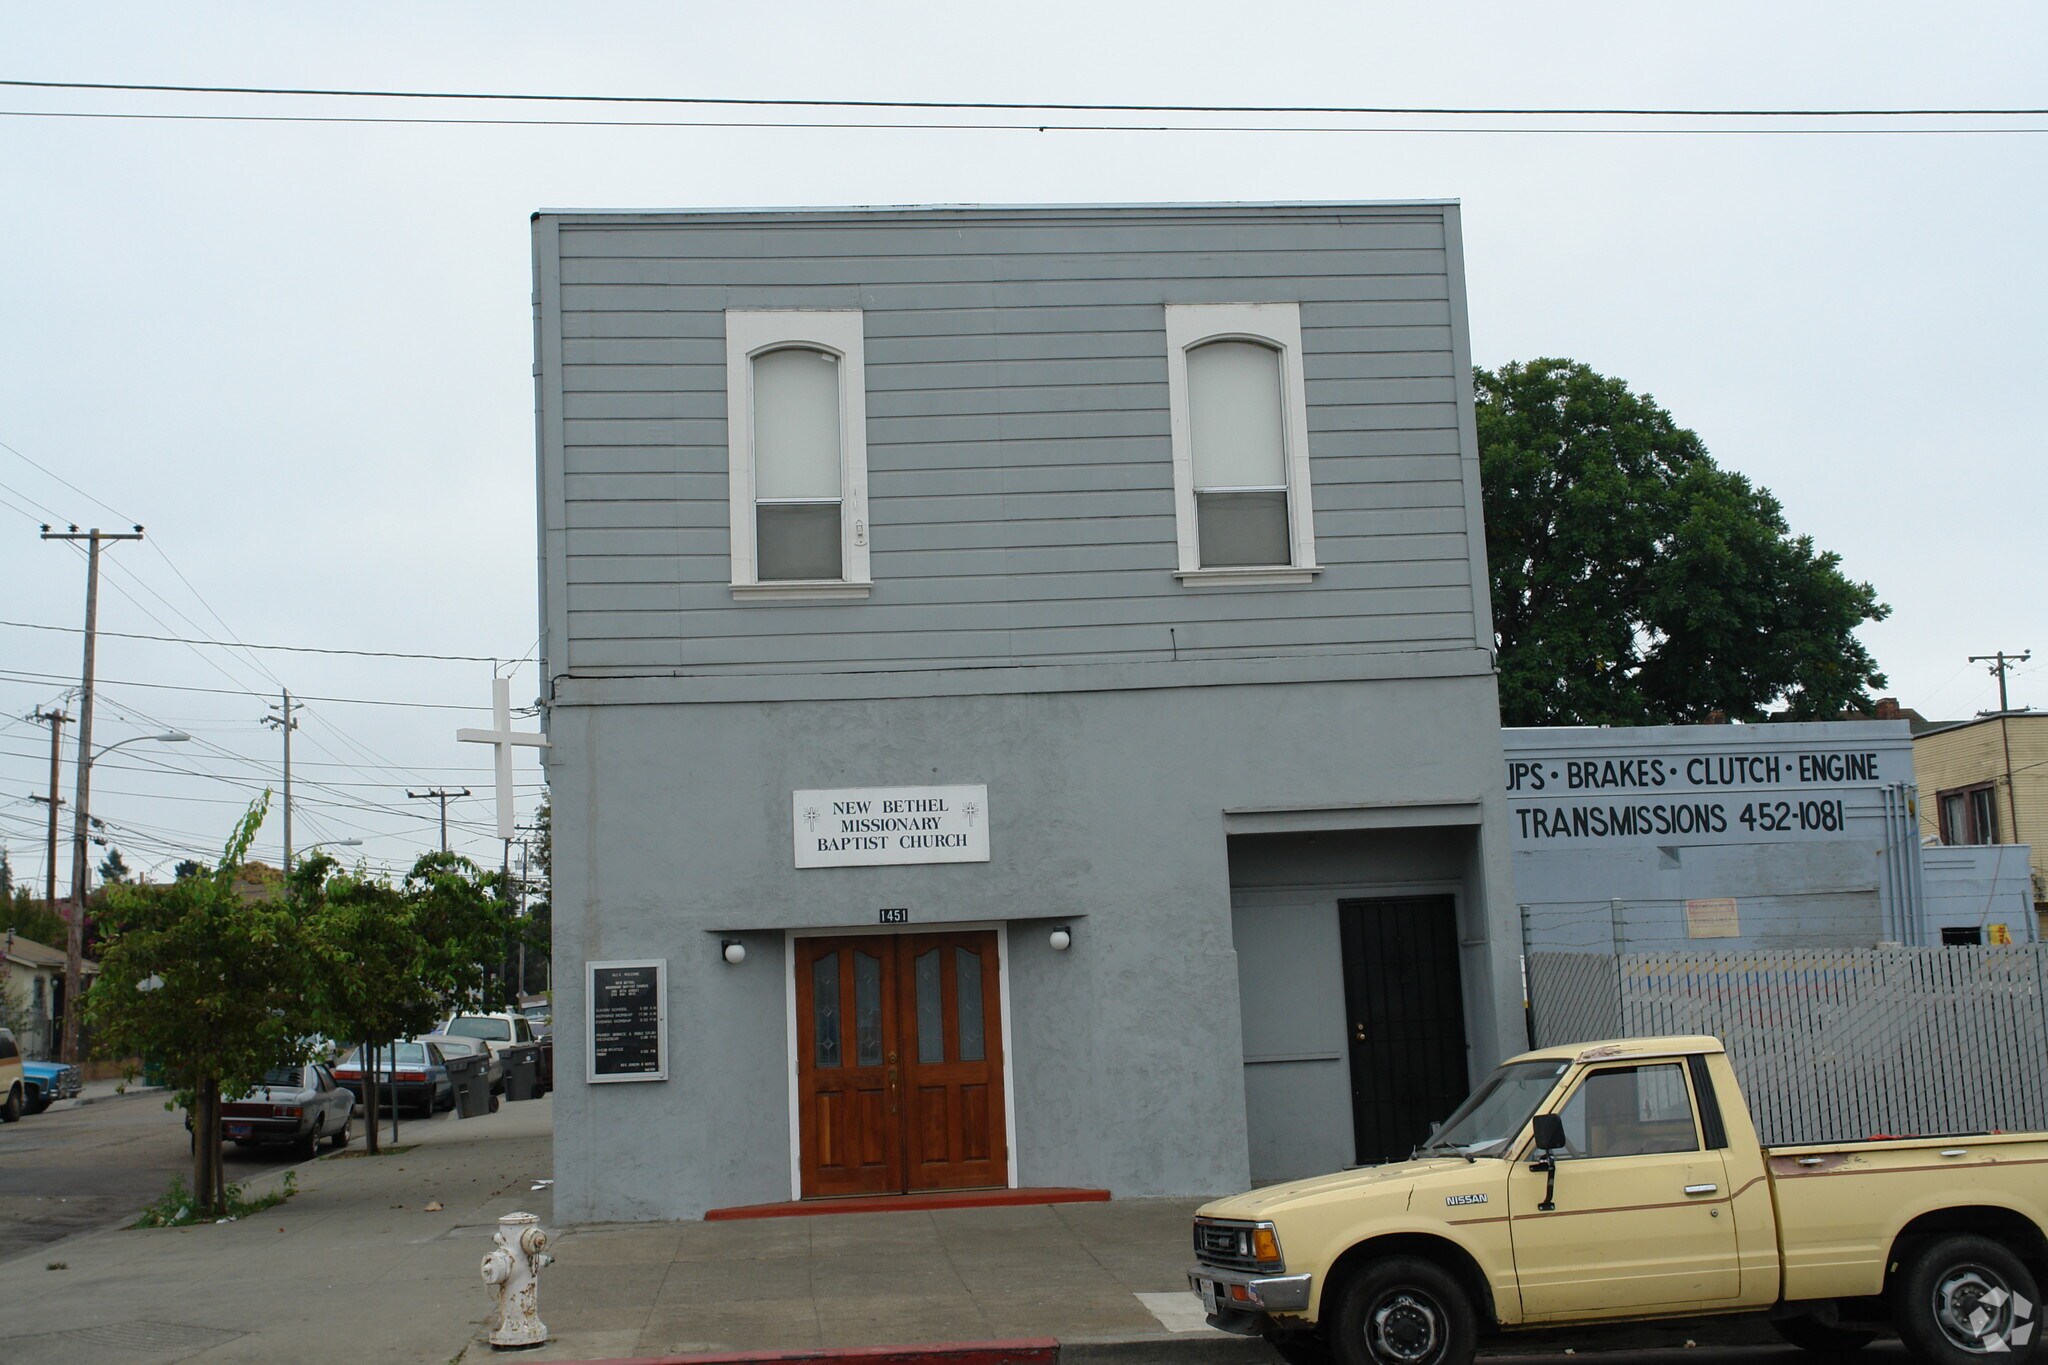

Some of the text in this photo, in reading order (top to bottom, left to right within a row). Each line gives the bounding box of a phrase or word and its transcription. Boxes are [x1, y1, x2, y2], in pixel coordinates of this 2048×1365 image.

[1567, 759, 1666, 789] BRAKES
[1686, 756, 1780, 785] CLUTCH
[1798, 753, 1880, 782] ENGINE
[833, 799, 949, 815] NEW BETHEL
[841, 817, 942, 833] MISSIONARY
[1516, 799, 1844, 839] TRANSMISSIONS 452-1081
[817, 834, 968, 851] BAPTIST CHURCH
[880, 910, 908, 922] 1451
[1446, 1194, 1488, 1205] NISSAN
